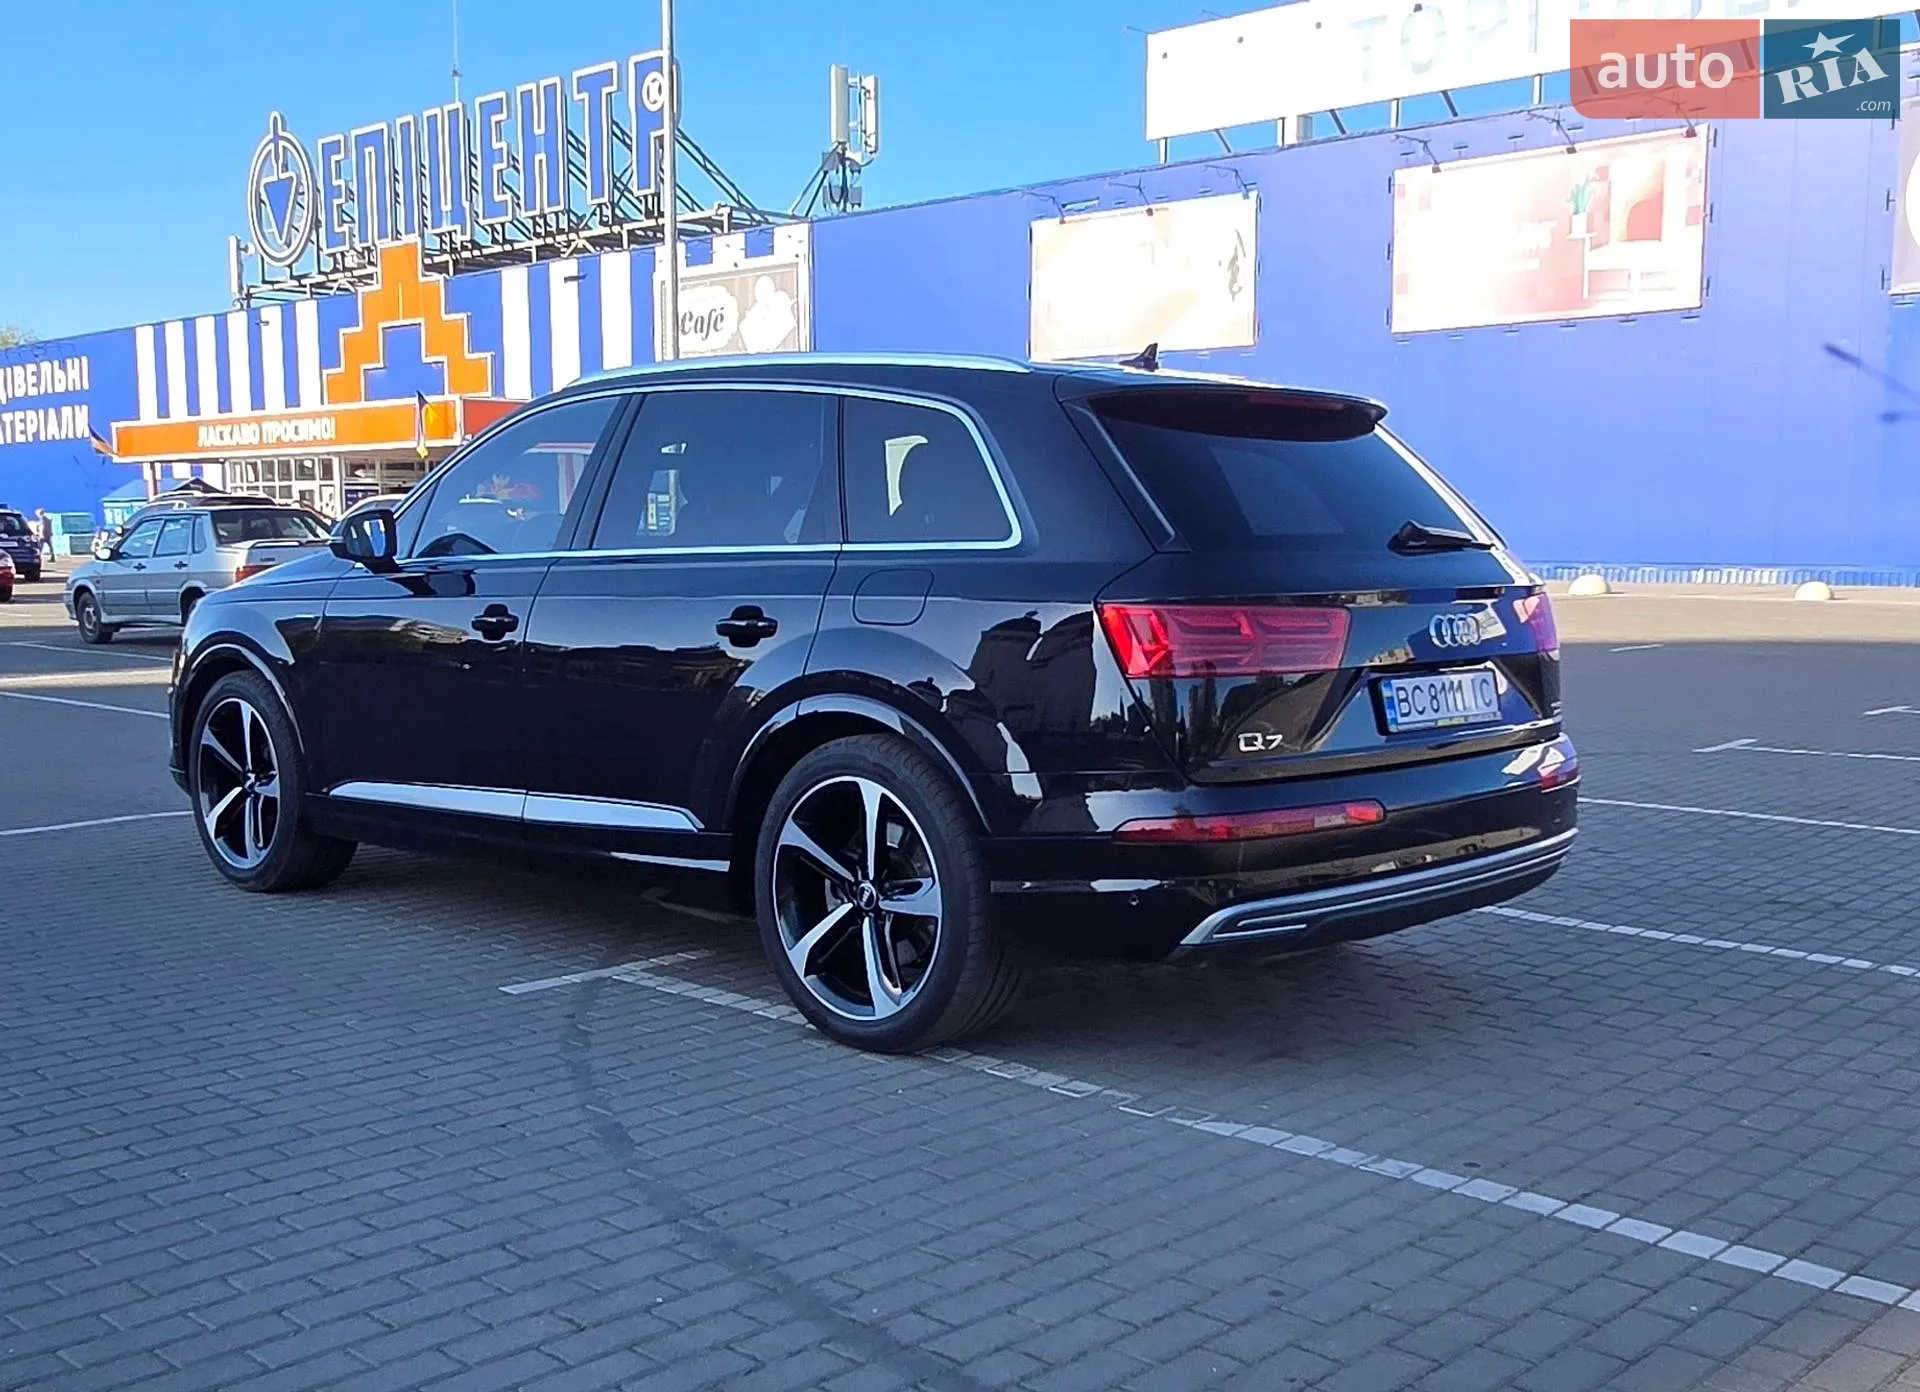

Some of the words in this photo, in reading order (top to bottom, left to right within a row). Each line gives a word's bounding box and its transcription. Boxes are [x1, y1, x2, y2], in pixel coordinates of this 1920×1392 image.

[317, 49, 678, 257] ЕПІЦЕНТР
[680, 306, 725, 341] Café
[198, 422, 260, 448] ЛАСКАВО
[261, 416, 336, 444] ПРОСИМО!
[1238, 732, 1283, 752] Q7
